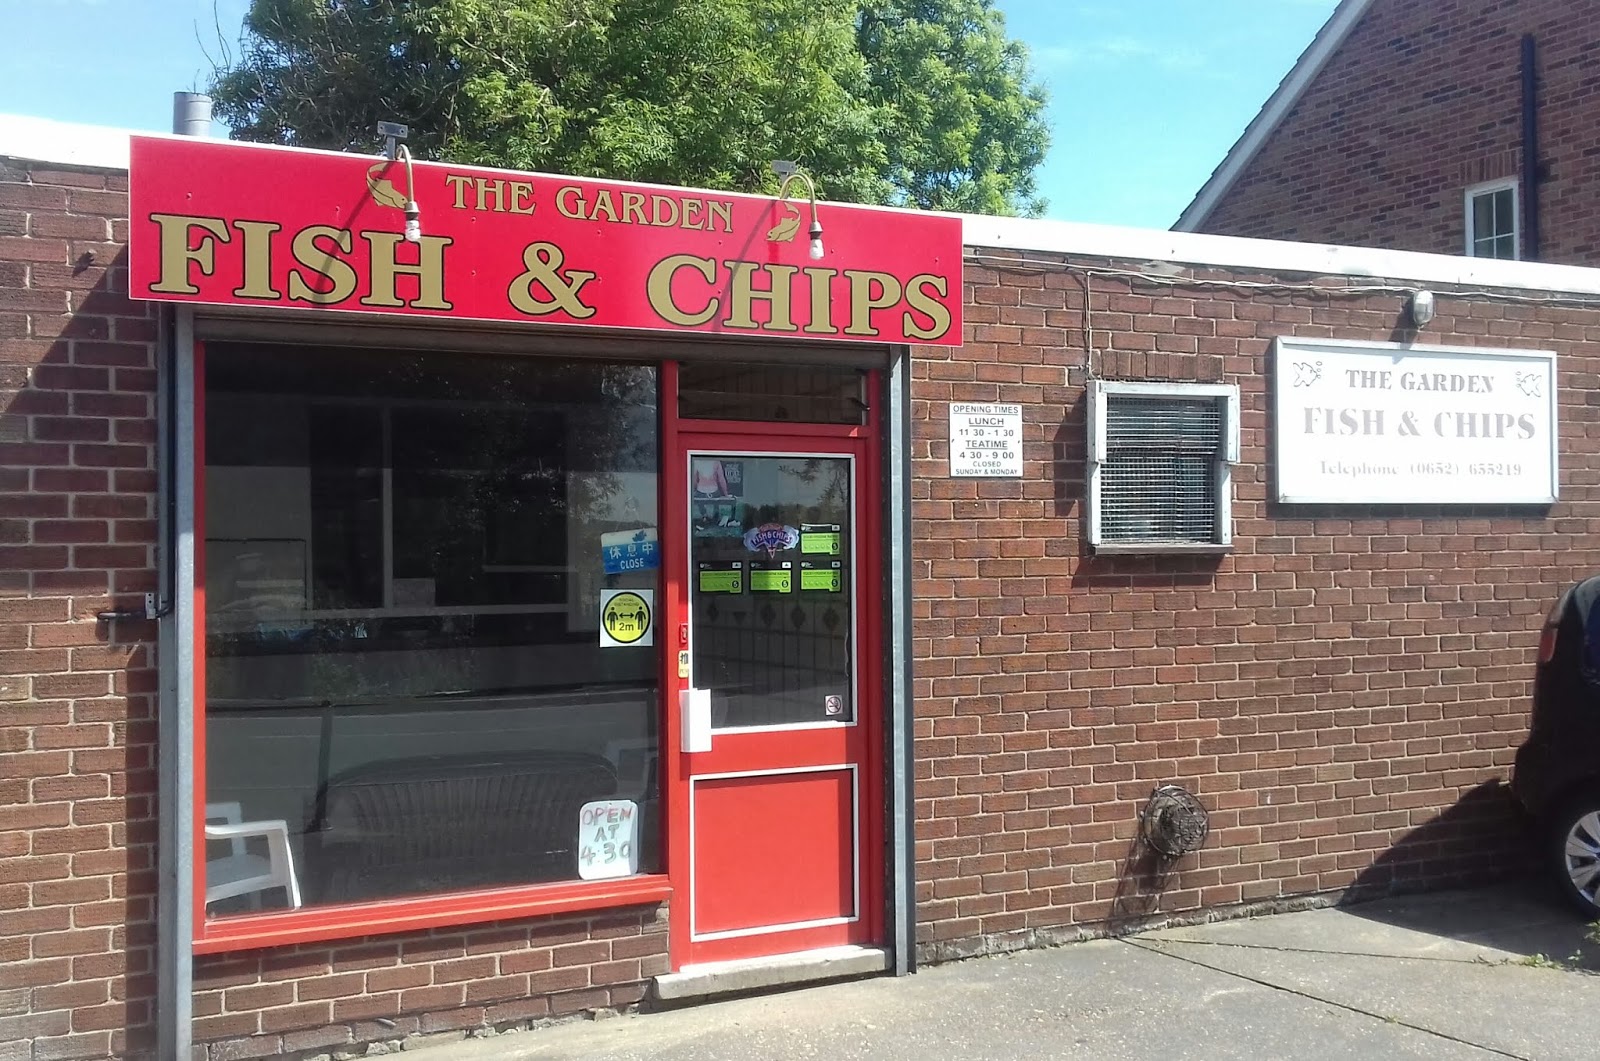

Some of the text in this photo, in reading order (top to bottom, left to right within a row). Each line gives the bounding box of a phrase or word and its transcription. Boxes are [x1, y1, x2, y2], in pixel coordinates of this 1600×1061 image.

[445, 174, 733, 233] THE GARDEN
[149, 212, 952, 341] FISH & CHIPS
[1345, 369, 1495, 394] THE GARDEN
[953, 405, 1019, 414] OPENING TIMES
[968, 417, 1004, 425] LUNCH
[1303, 406, 1536, 439] FISH & CHIPS
[965, 440, 1008, 448] TEATIME
[1321, 460, 1521, 478] Telephone (0652) 655219
[609, 542, 654, 560] 休息中
[620, 558, 645, 570] CLOSE
[619, 622, 634, 631] 2m
[582, 806, 633, 826] OPEN
[594, 824, 620, 842] AT
